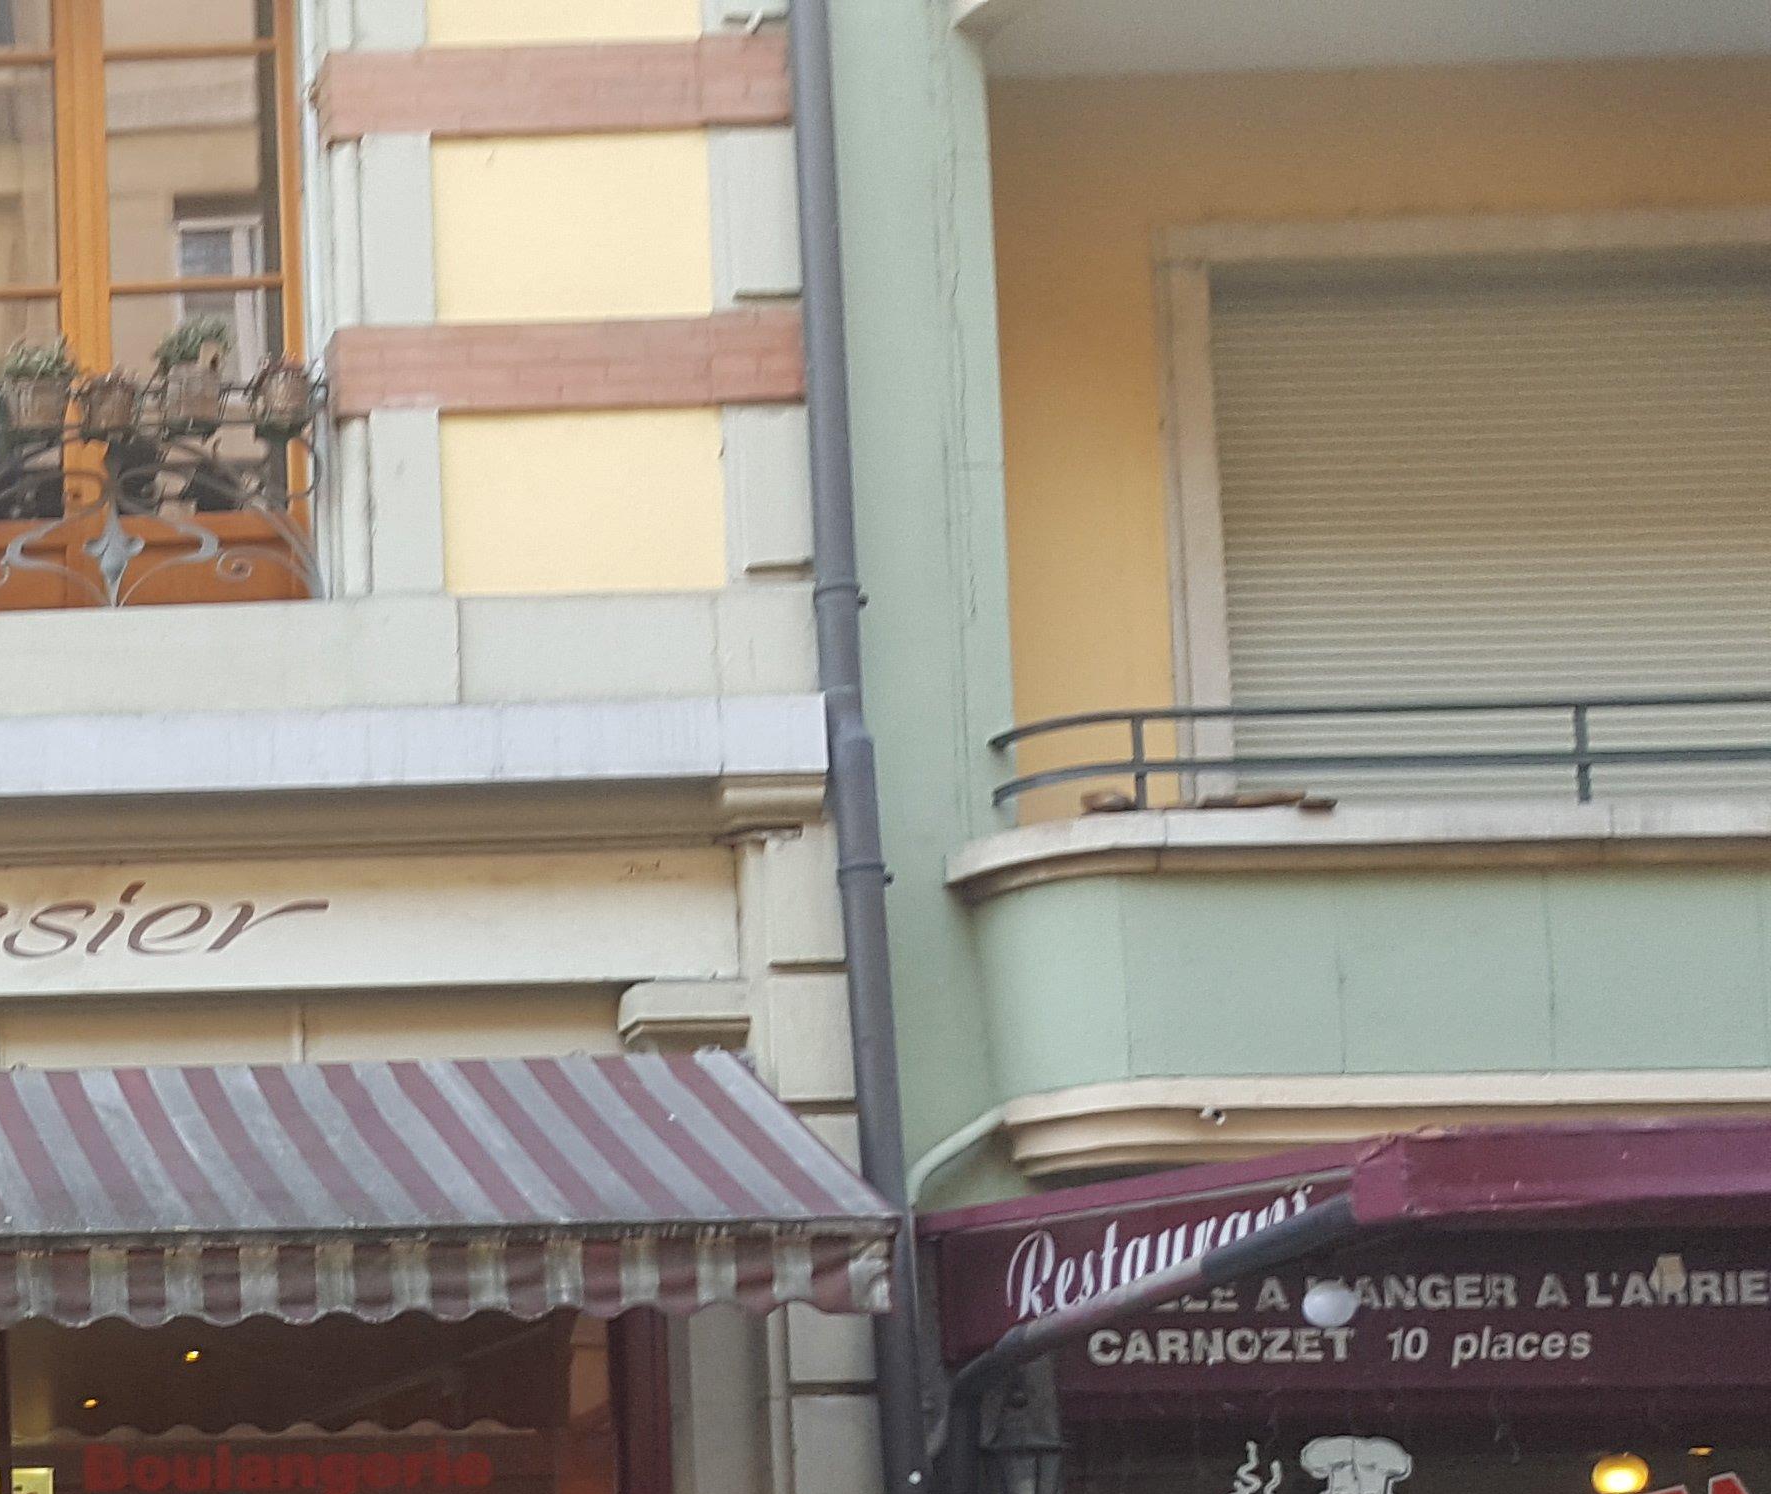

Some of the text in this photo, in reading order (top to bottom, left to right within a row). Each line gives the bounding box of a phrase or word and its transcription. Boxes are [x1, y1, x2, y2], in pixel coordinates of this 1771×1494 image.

[1087, 1324, 1593, 1368] CARNOZET 10 places
